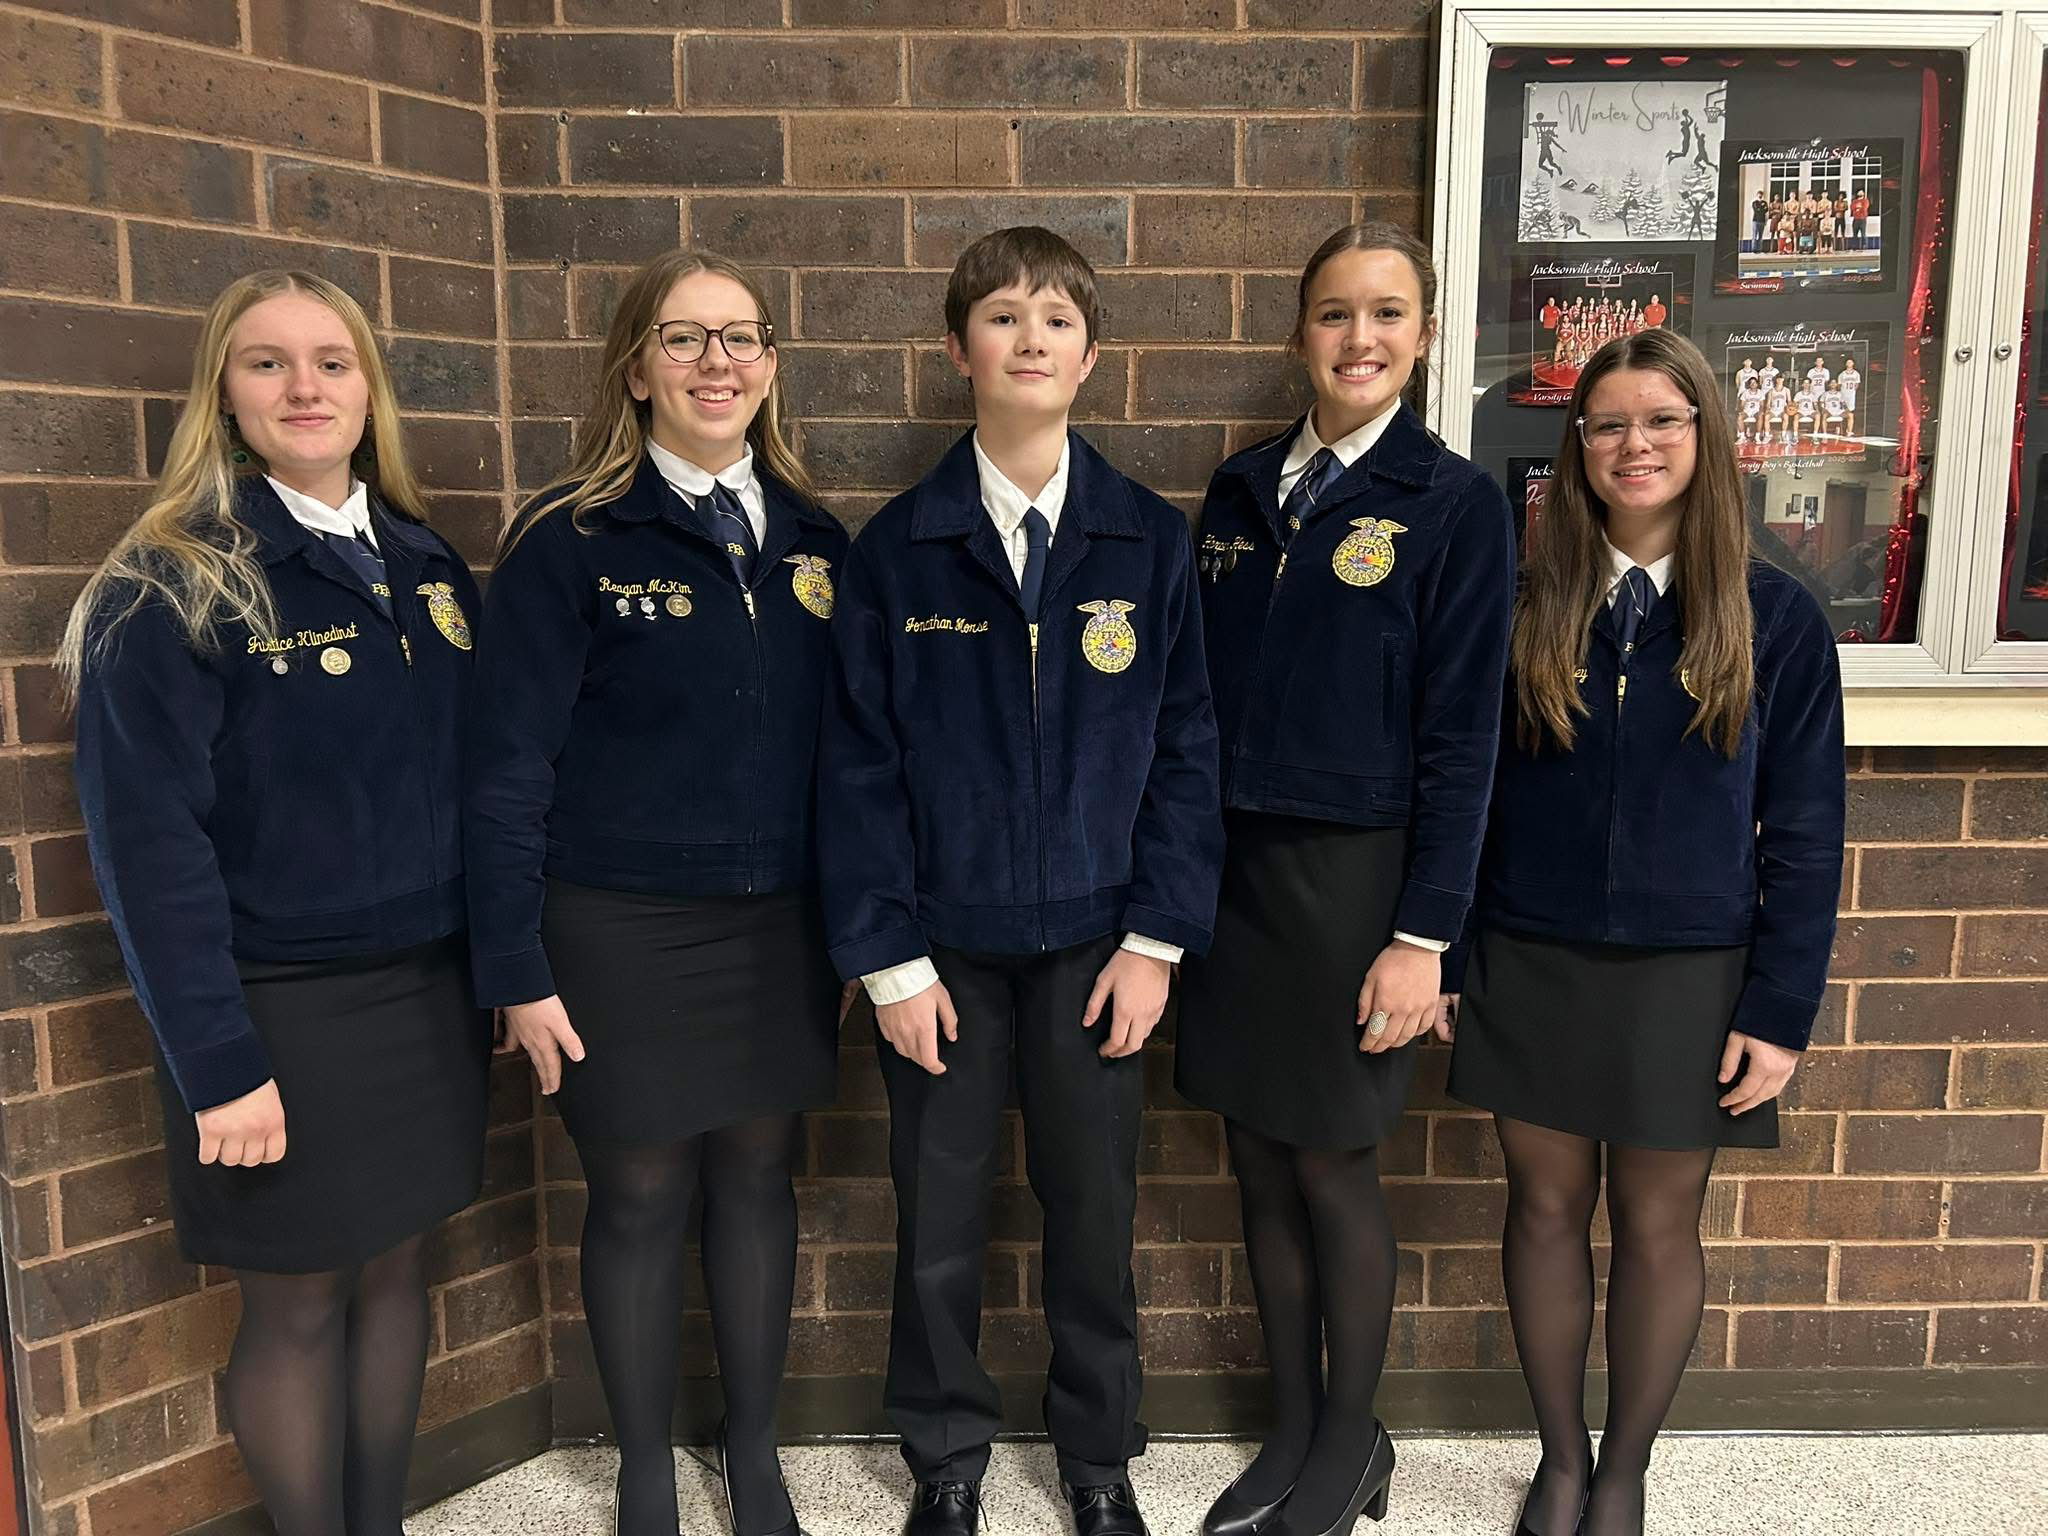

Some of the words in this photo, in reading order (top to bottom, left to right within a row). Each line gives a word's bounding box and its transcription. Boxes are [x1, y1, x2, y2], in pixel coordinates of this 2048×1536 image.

[1558, 87, 1629, 134] Winter
[1631, 81, 1680, 132] Sports
[1738, 147, 1800, 162] Jacksonville
[1801, 147, 1829, 161] High
[1831, 146, 1868, 159] School
[1530, 262, 1592, 276] Jacksonville
[1594, 262, 1620, 276] High
[1622, 261, 1659, 274] School
[1740, 282, 1779, 292] Swimming
[1726, 330, 1786, 344] Jacksonville
[1789, 330, 1816, 344] High
[1819, 329, 1855, 341] School
[1534, 393, 1561, 403] Varsity
[1783, 459, 1824, 469] Basketball
[727, 543, 745, 555] FFA
[599, 577, 645, 598] Reagan
[647, 578, 692, 593] McKim
[905, 613, 953, 632] Jonathan
[247, 635, 295, 654] Justice
[296, 622, 359, 646] Klinedinst
